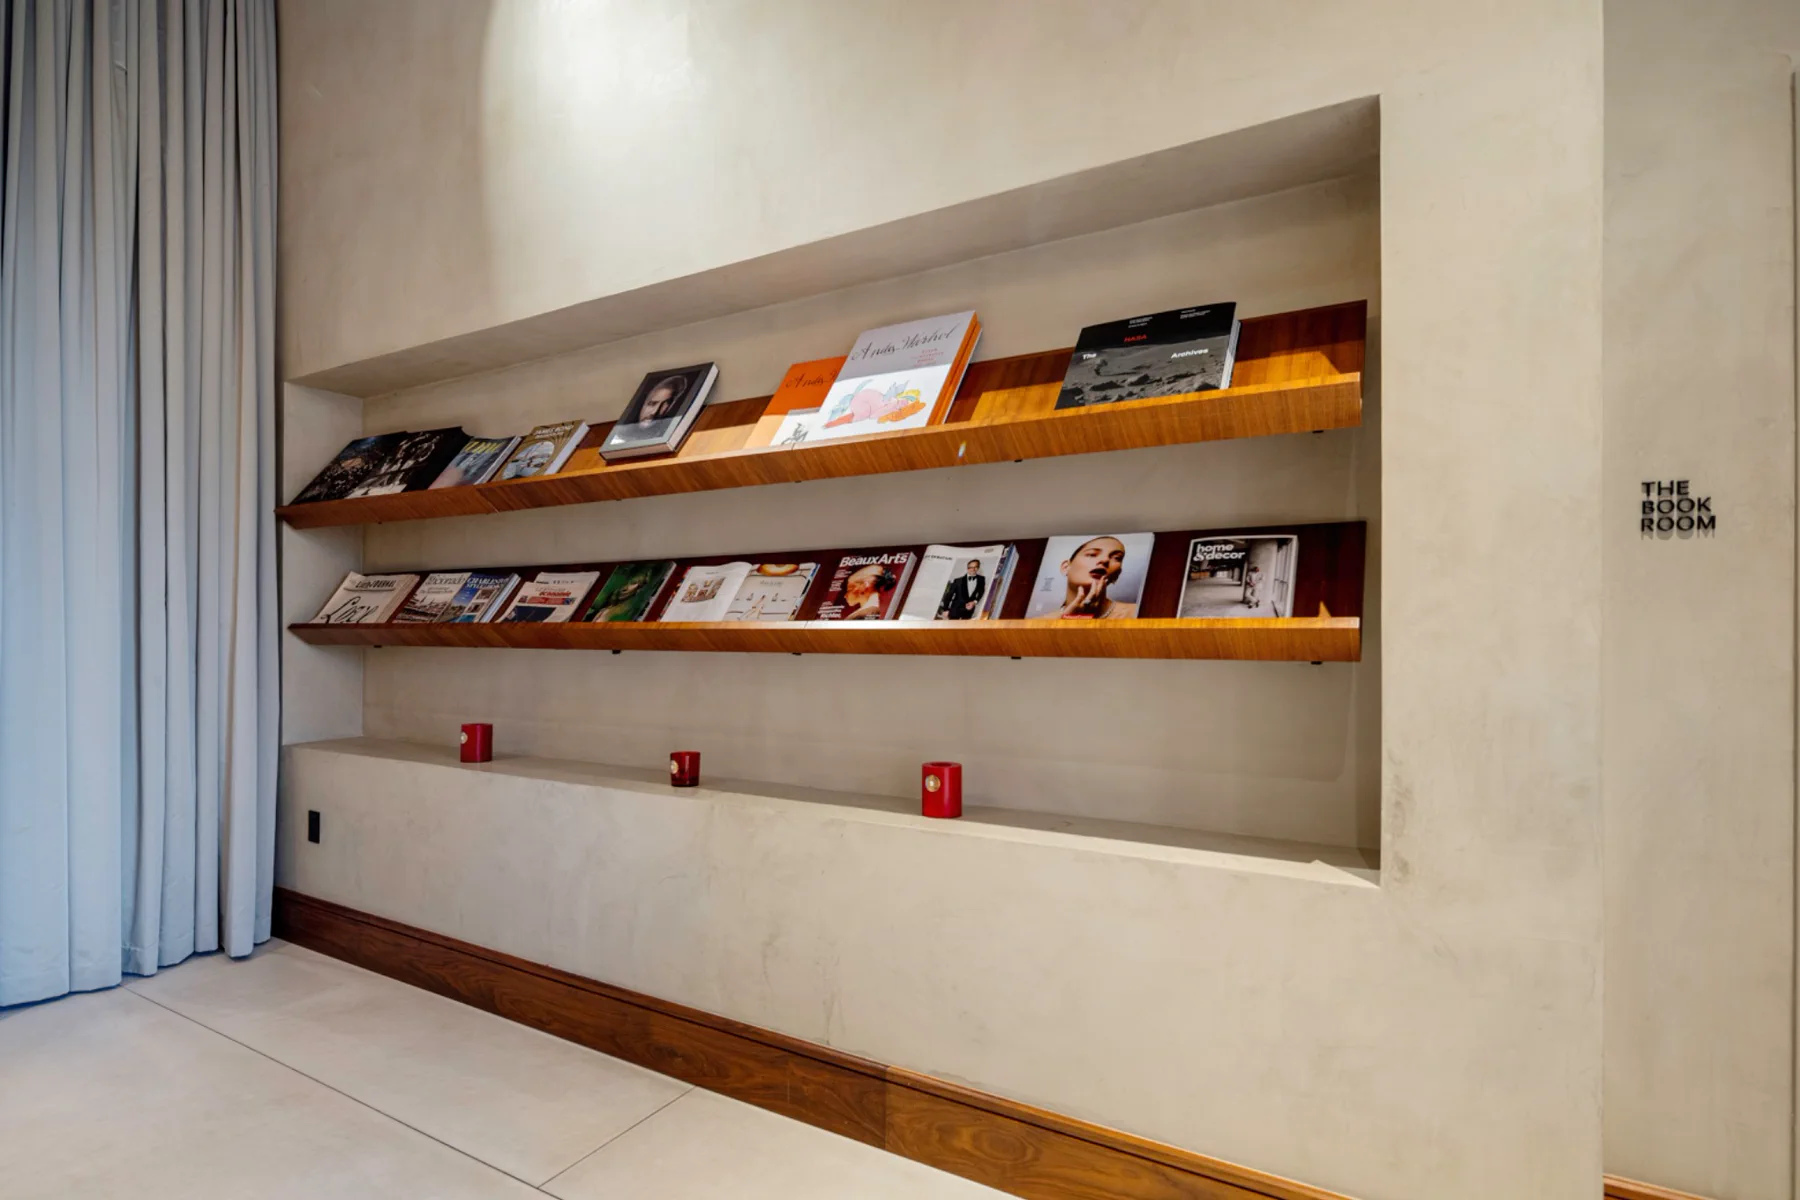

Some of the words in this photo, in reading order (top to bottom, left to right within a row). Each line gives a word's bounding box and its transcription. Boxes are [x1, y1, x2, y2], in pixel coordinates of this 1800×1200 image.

[1124, 334, 1147, 342] NASA
[1082, 352, 1097, 361] The
[1170, 347, 1209, 359] Archives
[1641, 480, 1690, 497] THE
[1642, 496, 1712, 514] BOOK
[1641, 515, 1716, 532] ROOM
[1196, 543, 1234, 554] home
